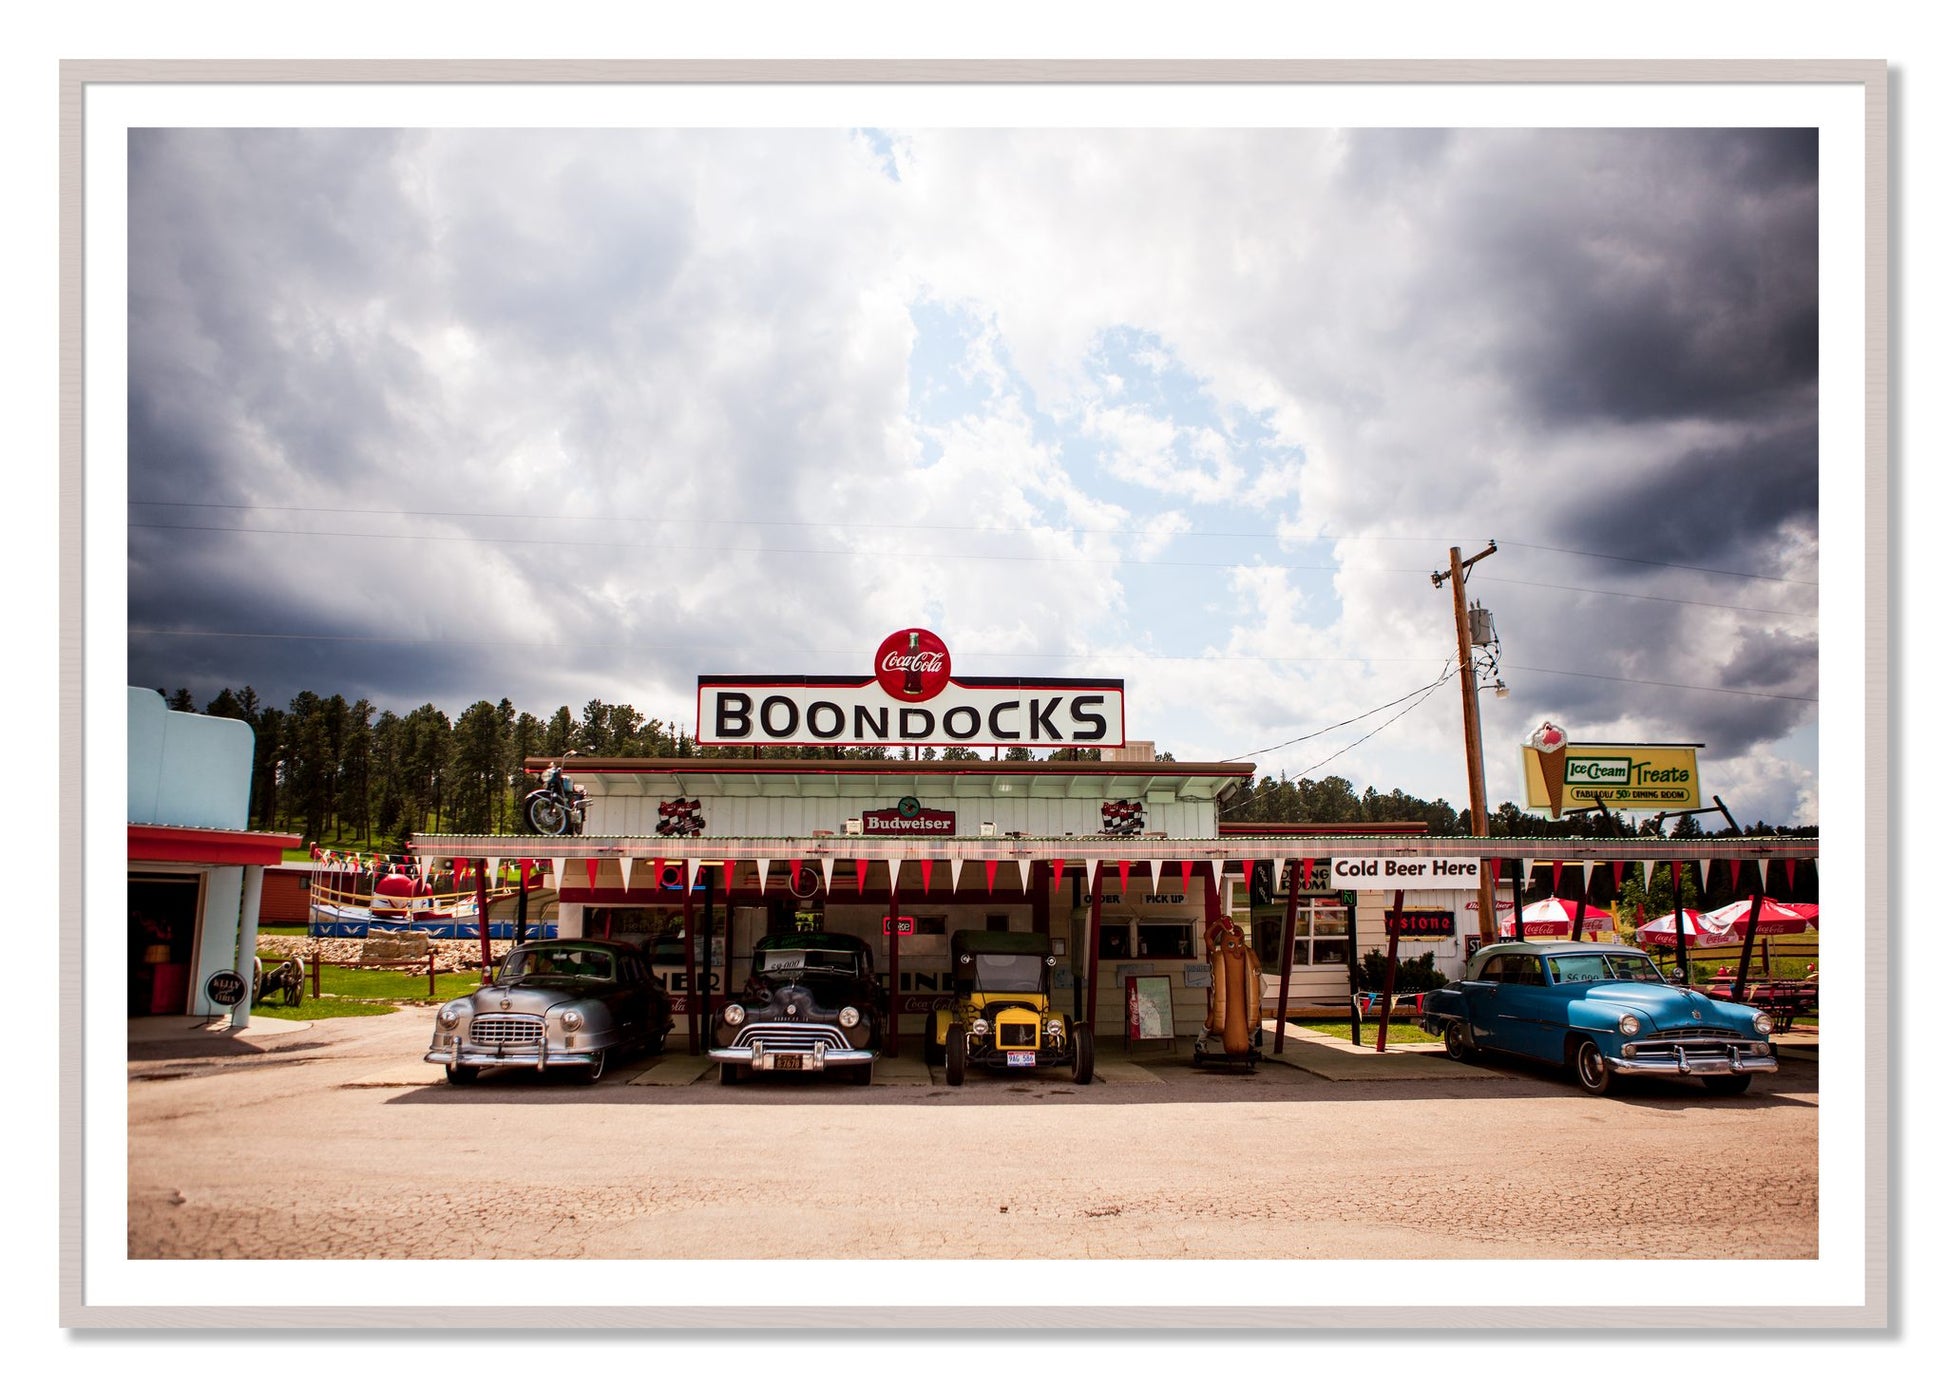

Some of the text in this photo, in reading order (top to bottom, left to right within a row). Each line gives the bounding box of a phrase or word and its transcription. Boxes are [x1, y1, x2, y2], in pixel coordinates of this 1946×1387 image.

[882, 651, 945, 672] Coca-Cola
[716, 692, 1106, 741] BOONDOCKS
[1570, 763, 1626, 779] Ice Cream
[1632, 762, 1689, 785] Treats
[1633, 791, 1658, 799] DINING
[1660, 791, 1684, 799] ROOM
[867, 817, 951, 830] Budweiser
[1336, 861, 1477, 876] Cold Beer Here
[1084, 895, 1120, 903] ODER
[1146, 895, 1185, 903] PICK UP
